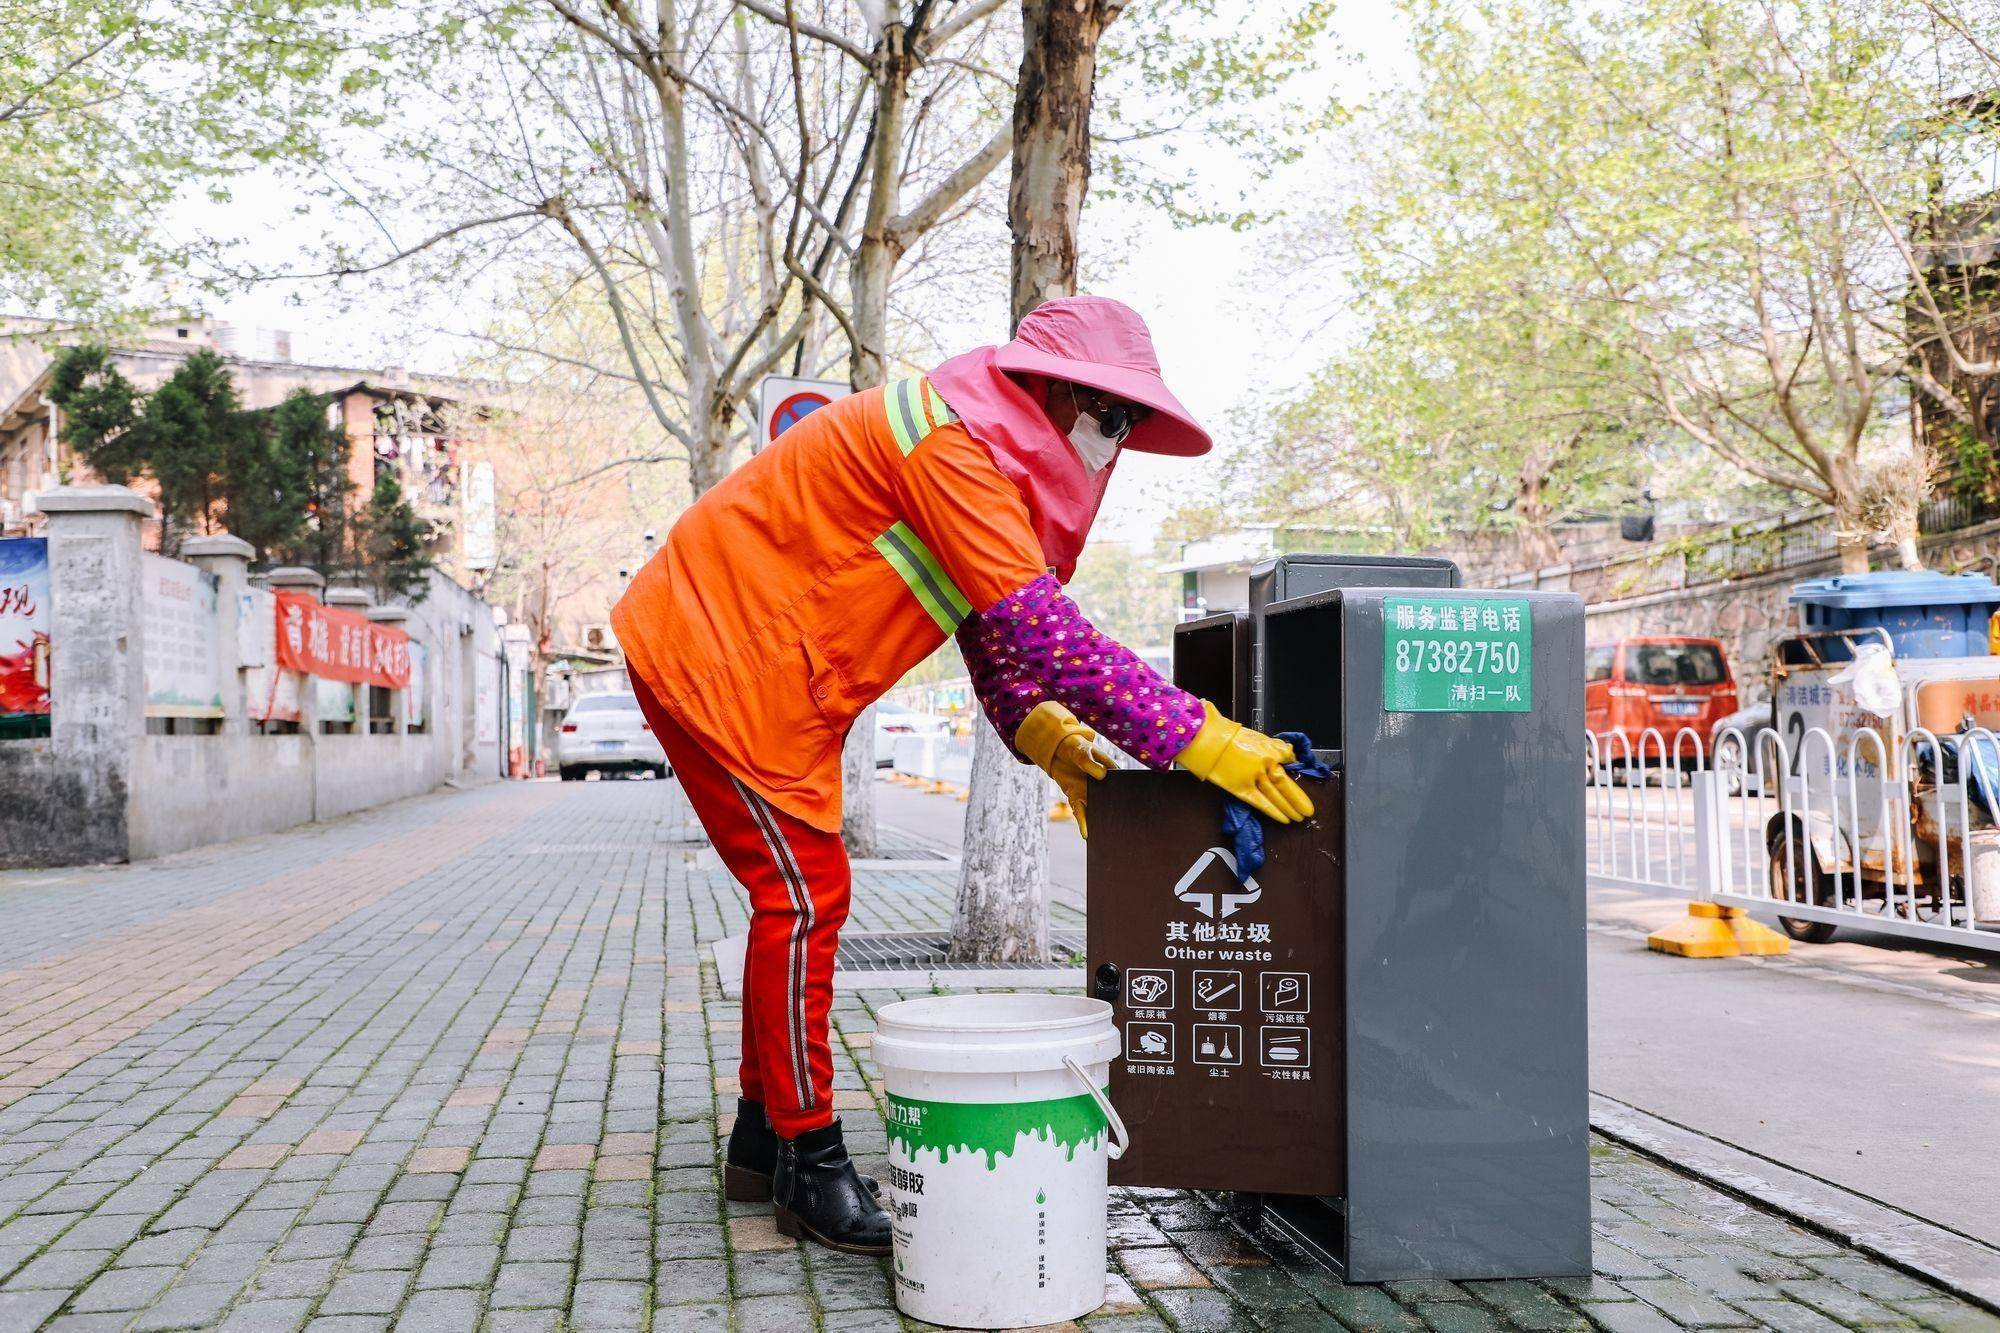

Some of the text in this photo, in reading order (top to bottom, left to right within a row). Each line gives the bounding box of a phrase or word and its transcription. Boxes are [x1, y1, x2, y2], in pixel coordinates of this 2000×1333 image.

[1396, 605, 1521, 632] 服务监督电话
[1395, 639, 1520, 674] 87382750
[1451, 684, 1521, 702] 清扫一队
[1786, 685, 1832, 706] 清洁城市
[1788, 711, 1809, 783] 2
[1166, 921, 1272, 944] 其他垃圾
[1164, 945, 1273, 962] Other waste
[1134, 1009, 1167, 1020] 纸尿裤
[1207, 1011, 1228, 1021] 烟蒂
[1265, 1013, 1305, 1024] 污染纸张
[1126, 1064, 1175, 1076] 破旧陶瓷品
[1209, 1067, 1230, 1078] 尘土
[1262, 1069, 1311, 1081] 一次性餐具
